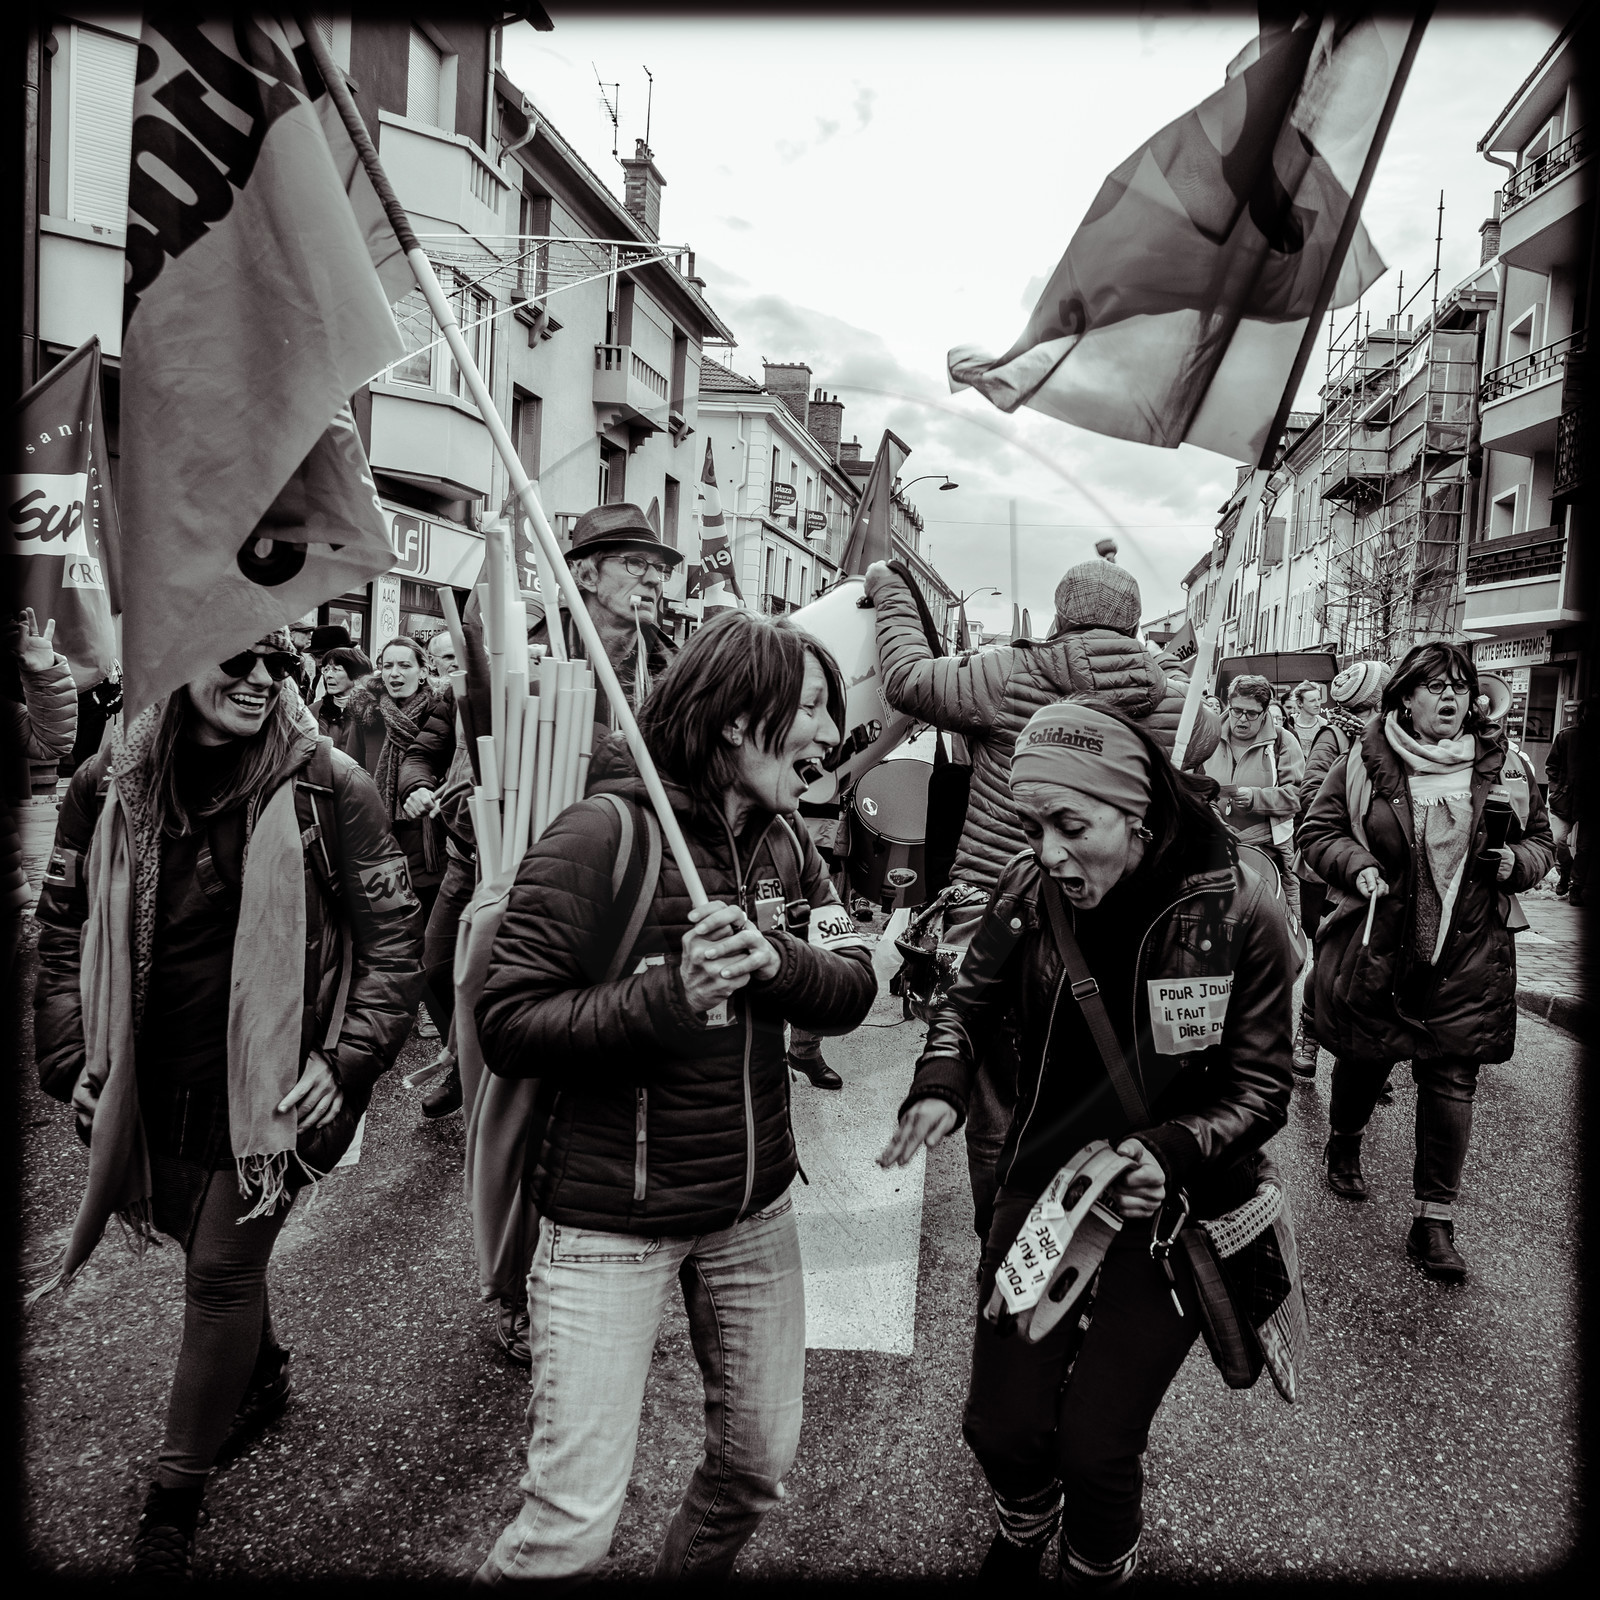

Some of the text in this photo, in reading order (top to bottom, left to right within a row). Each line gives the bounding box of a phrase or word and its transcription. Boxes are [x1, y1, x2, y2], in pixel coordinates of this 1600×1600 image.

[1478, 644, 1495, 662] CARTE
[1495, 641, 1512, 660] GRISE
[1512, 640, 1520, 658] ET
[1521, 636, 1544, 657] PERMIS
[1026, 727, 1104, 753] Solidaires
[1160, 986, 1194, 1001] POUR
[1176, 1006, 1206, 1020] FAUT
[1015, 1237, 1039, 1269] FAUT
